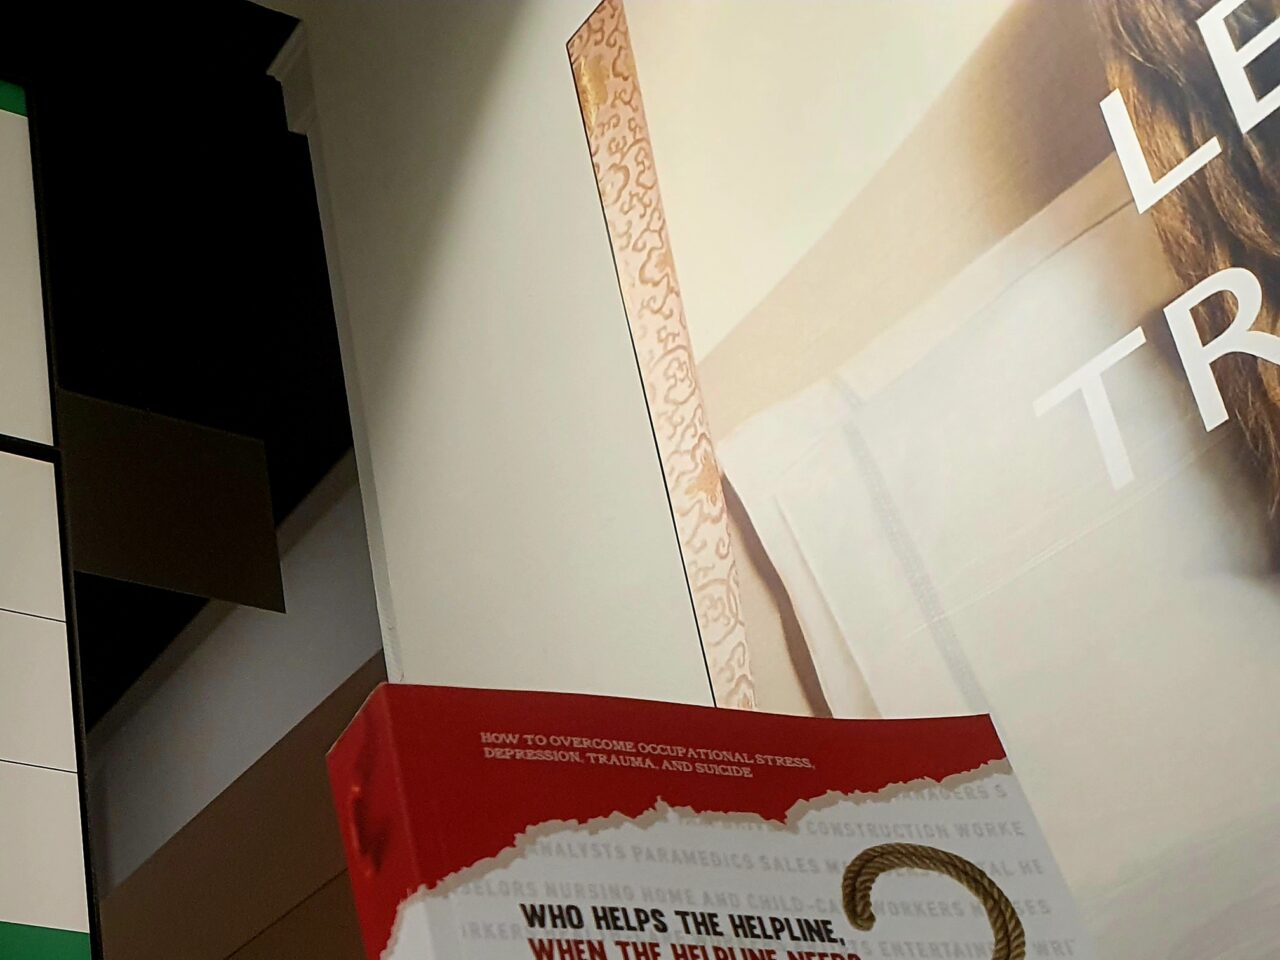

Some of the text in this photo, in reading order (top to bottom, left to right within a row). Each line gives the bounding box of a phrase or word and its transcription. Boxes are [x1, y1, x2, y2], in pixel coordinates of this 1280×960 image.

[480, 732, 520, 746] HOW
[522, 734, 547, 747] TO
[549, 736, 636, 752] OVERCOME
[638, 741, 755, 764] OCCUPATIONAL
[661, 760, 693, 773] AND
[695, 763, 753, 778] SUICIDE
[519, 903, 846, 946] WHO HELPS THE HELPLINE,
